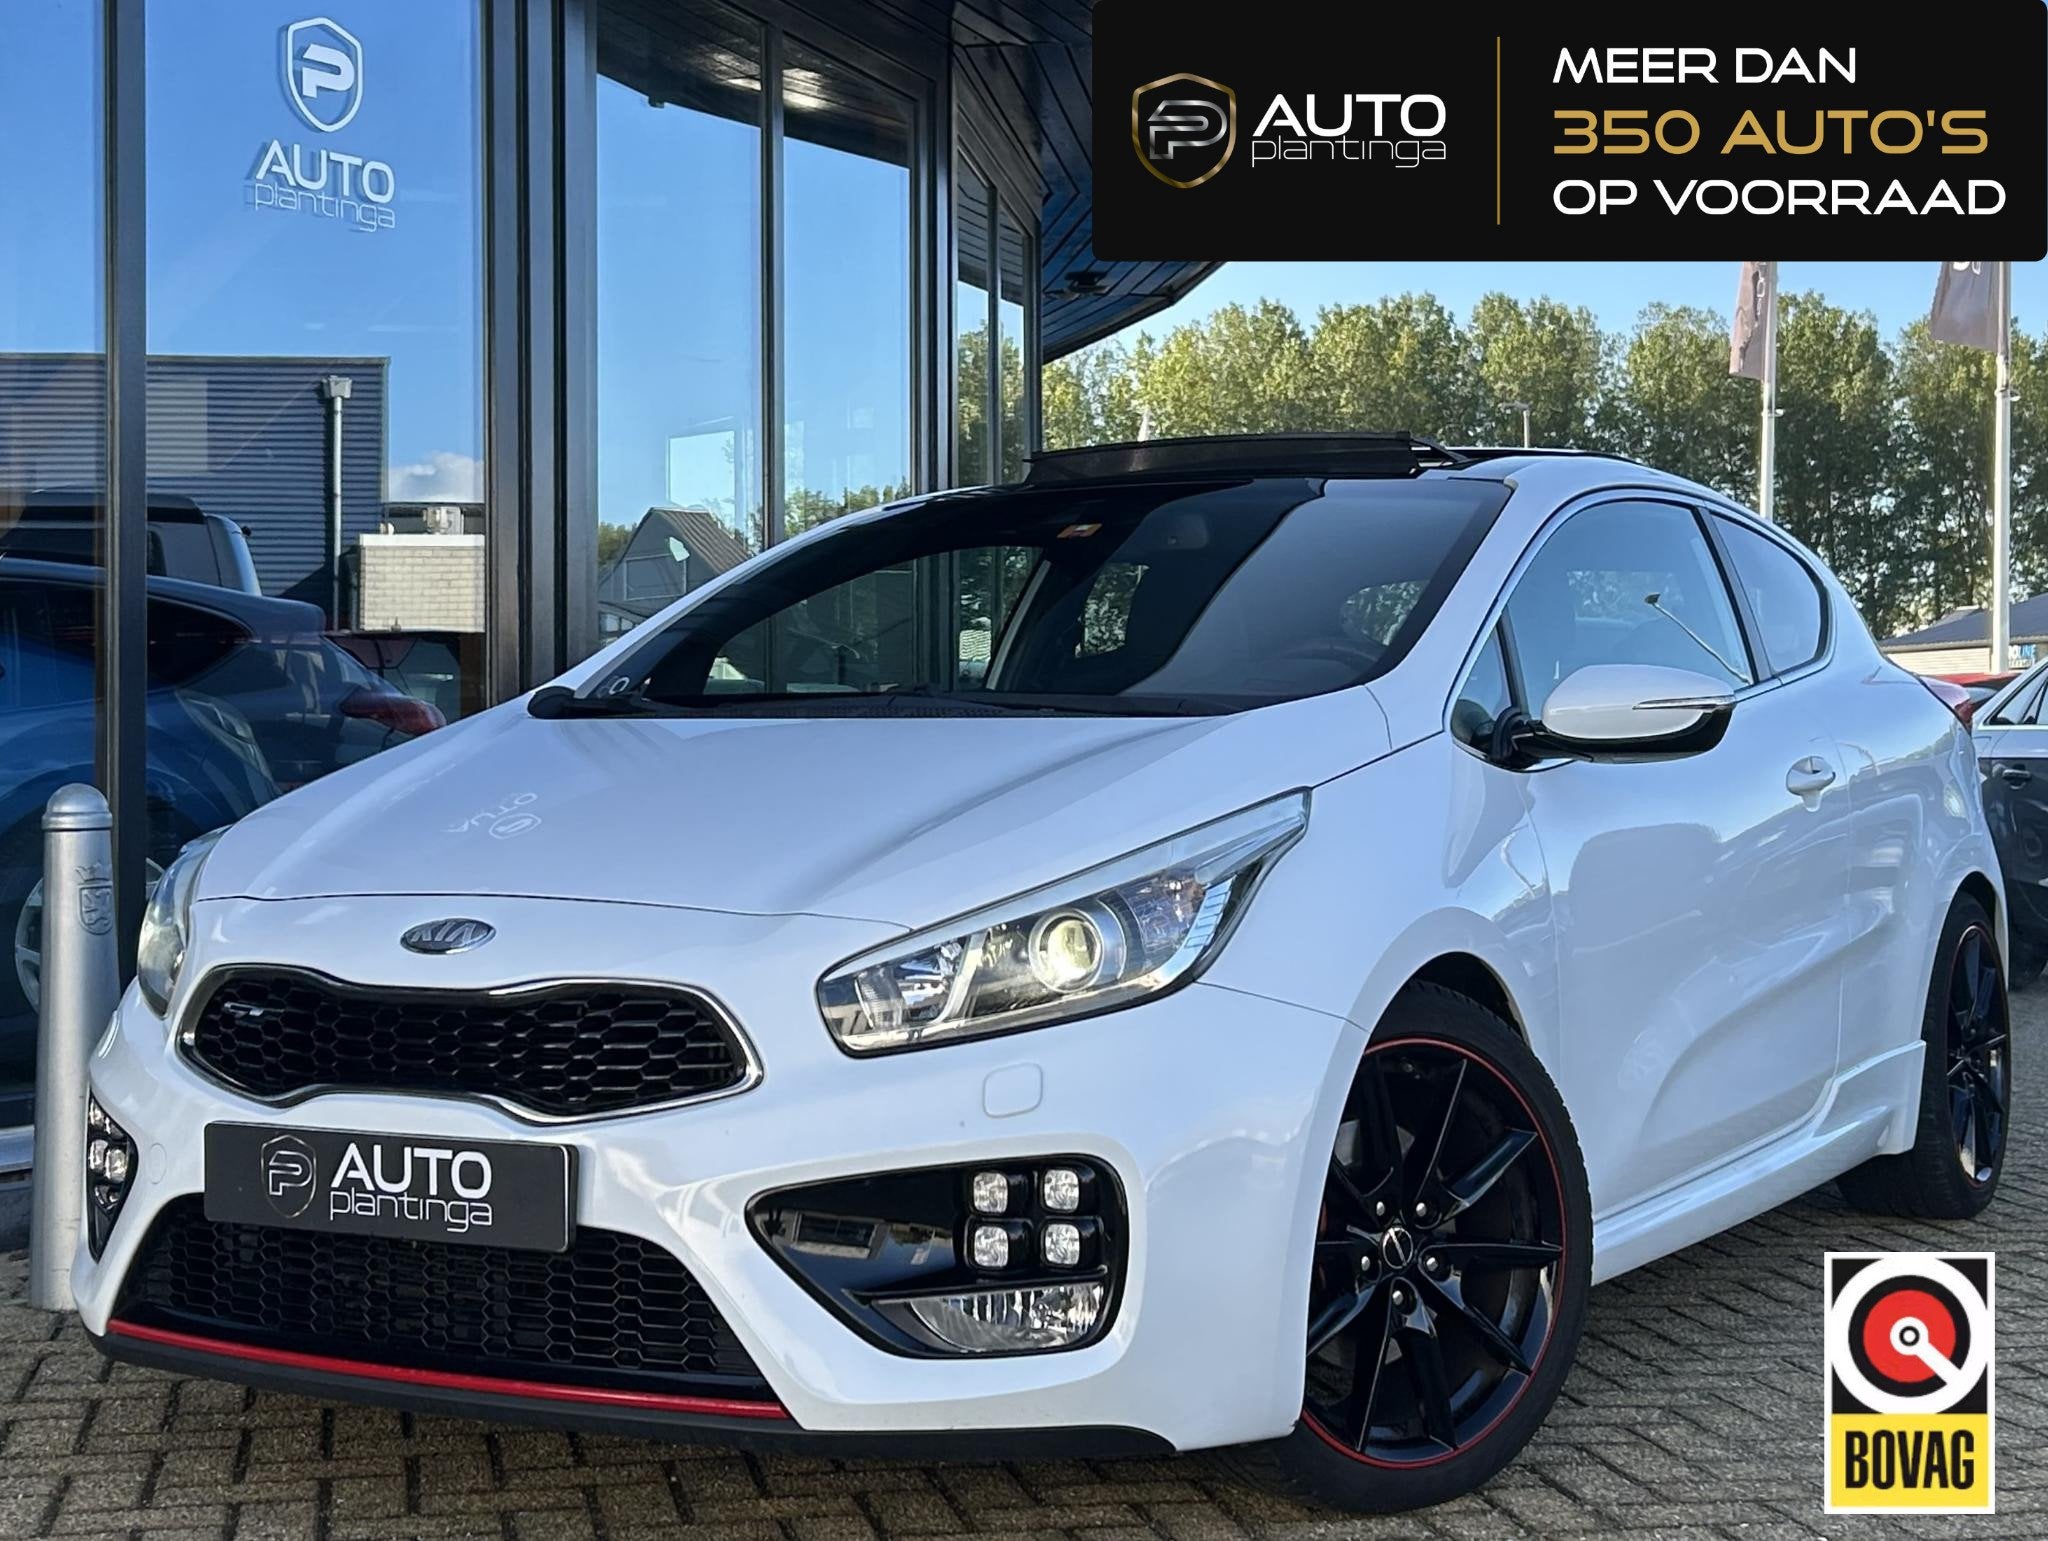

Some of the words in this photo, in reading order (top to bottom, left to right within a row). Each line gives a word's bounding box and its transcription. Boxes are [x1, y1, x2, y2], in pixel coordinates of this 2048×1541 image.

[255, 139, 395, 204] AUTO
[254, 182, 396, 232] plantinga
[330, 1142, 492, 1199] AUTO
[329, 1189, 493, 1233] plantinga
